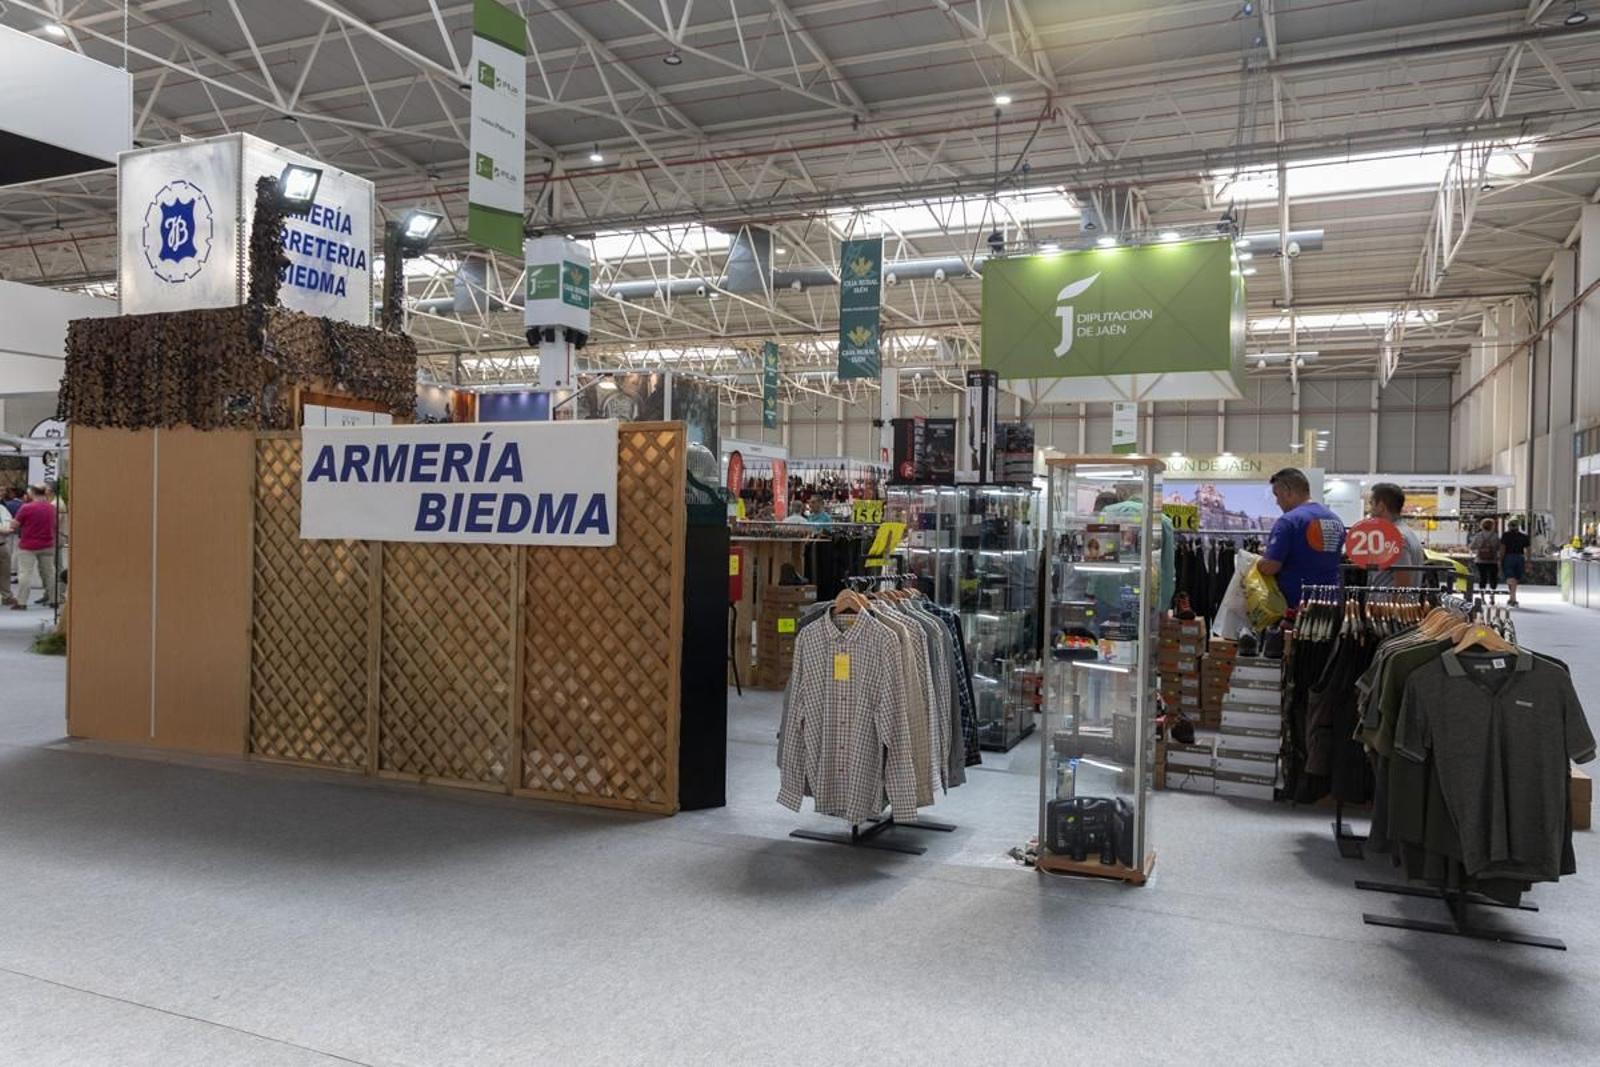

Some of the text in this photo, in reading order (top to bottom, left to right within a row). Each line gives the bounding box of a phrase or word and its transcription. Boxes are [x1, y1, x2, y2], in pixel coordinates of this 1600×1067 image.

[279, 226, 366, 271] RRETERIA
[1076, 309, 1153, 324] DIPUTACIÓN
[1076, 323, 1127, 337] DE JAÉN
[307, 431, 524, 483] ARMERÍA
[414, 492, 611, 536] BIEDMA
[1350, 530, 1400, 556] 20%
